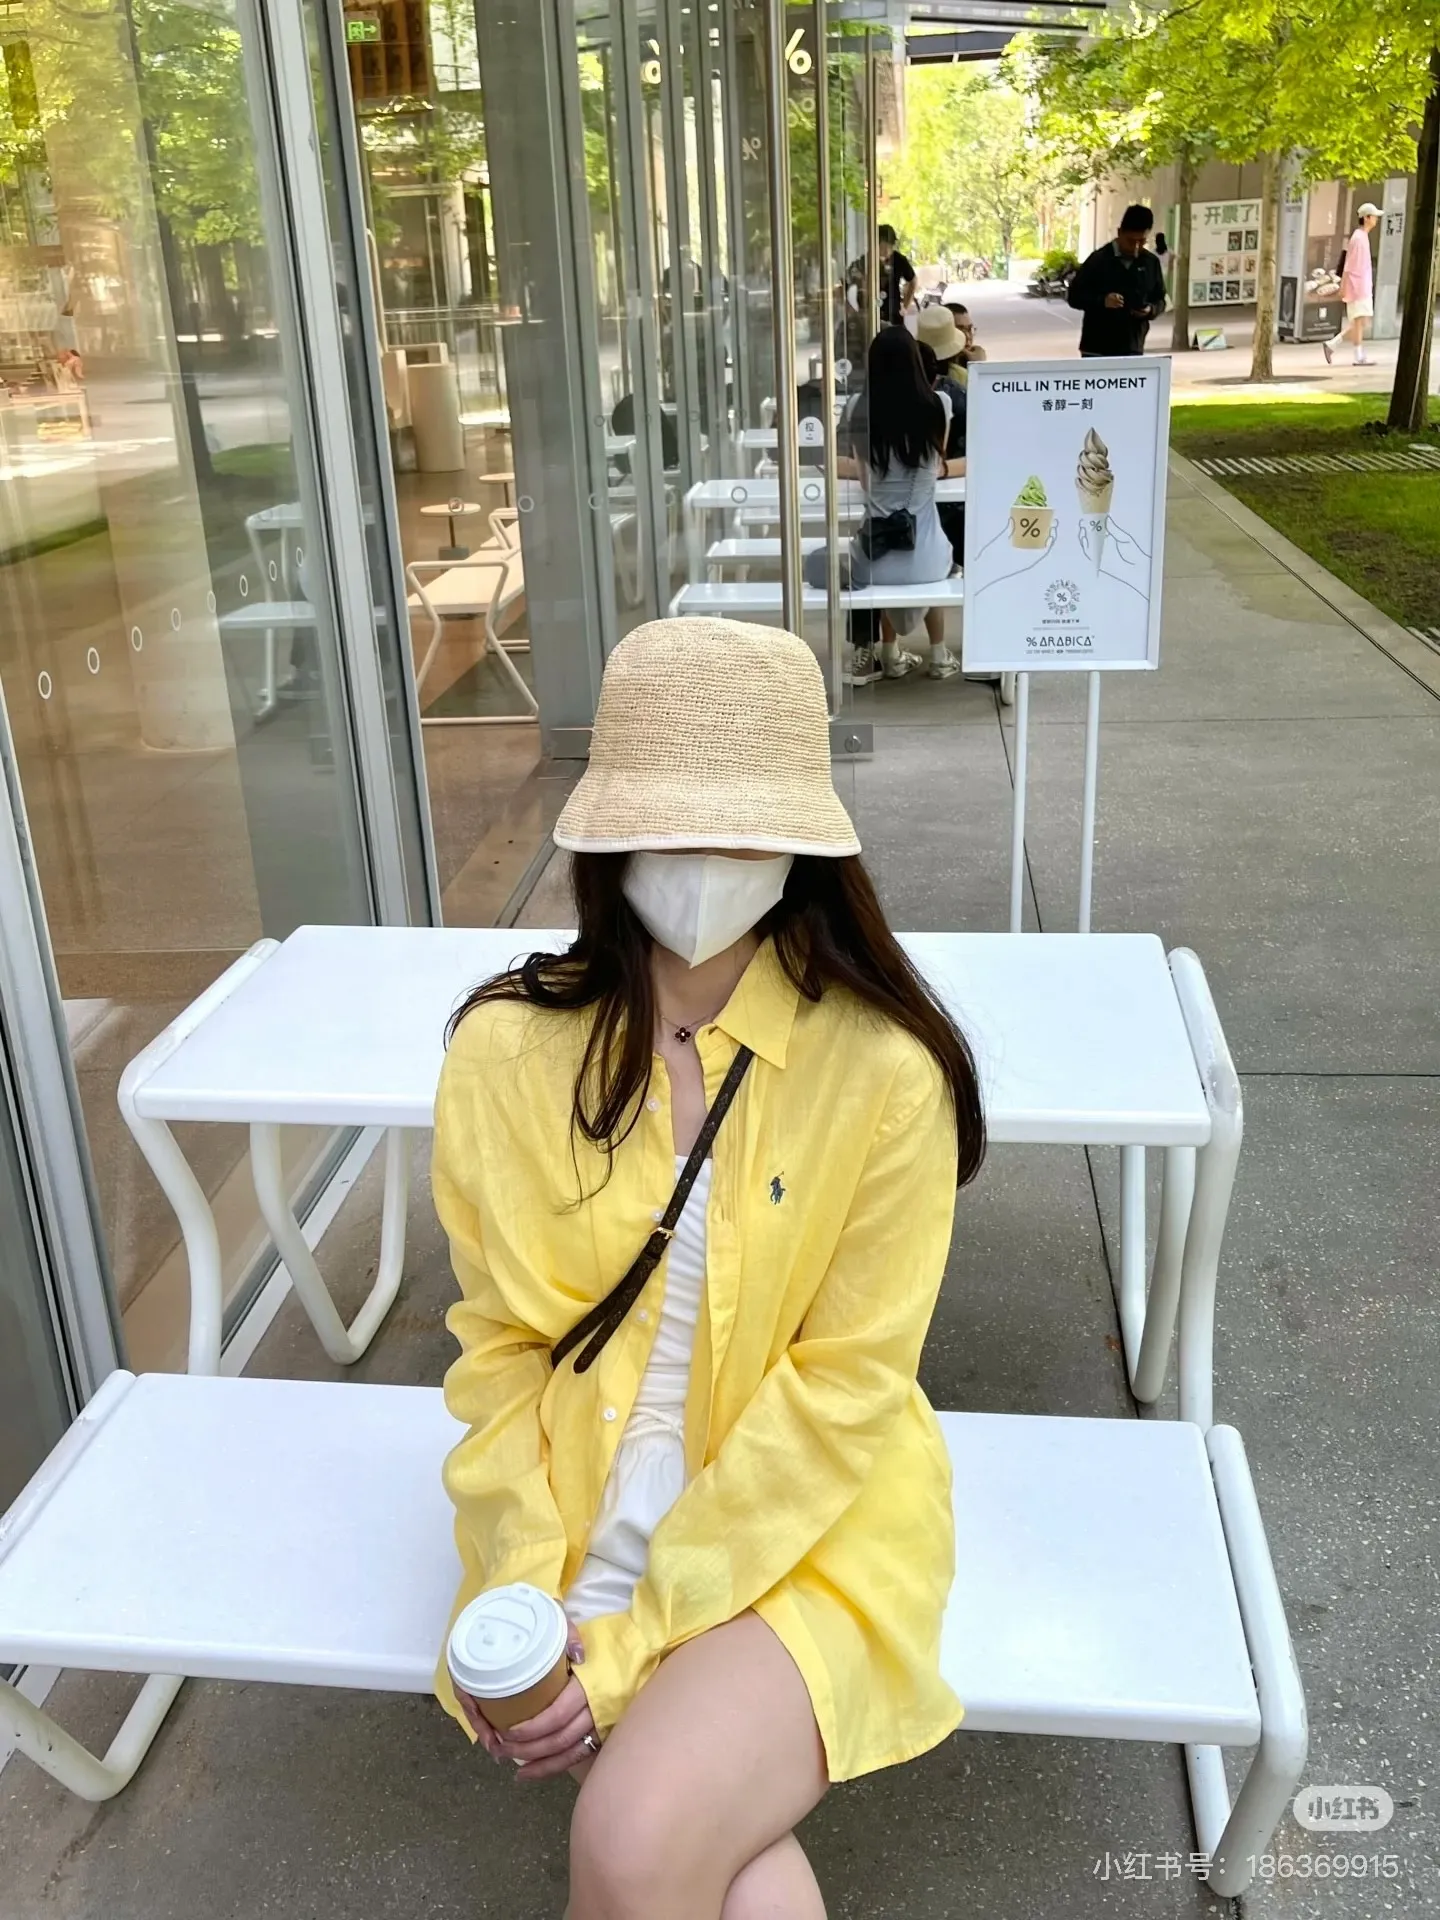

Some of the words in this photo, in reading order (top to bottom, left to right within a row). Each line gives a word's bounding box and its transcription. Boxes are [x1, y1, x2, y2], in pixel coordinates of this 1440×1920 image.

[991, 381, 1031, 393] CHILL
[1035, 380, 1049, 391] IN
[1053, 379, 1081, 391] THE
[1085, 377, 1147, 390] MOMENT
[1042, 398, 1094, 411] 香醇一刻
[1020, 518, 1040, 538] %
[1090, 520, 1102, 532] %
[1026, 636, 1037, 647] %
[1039, 635, 1092, 647] ARABICA
